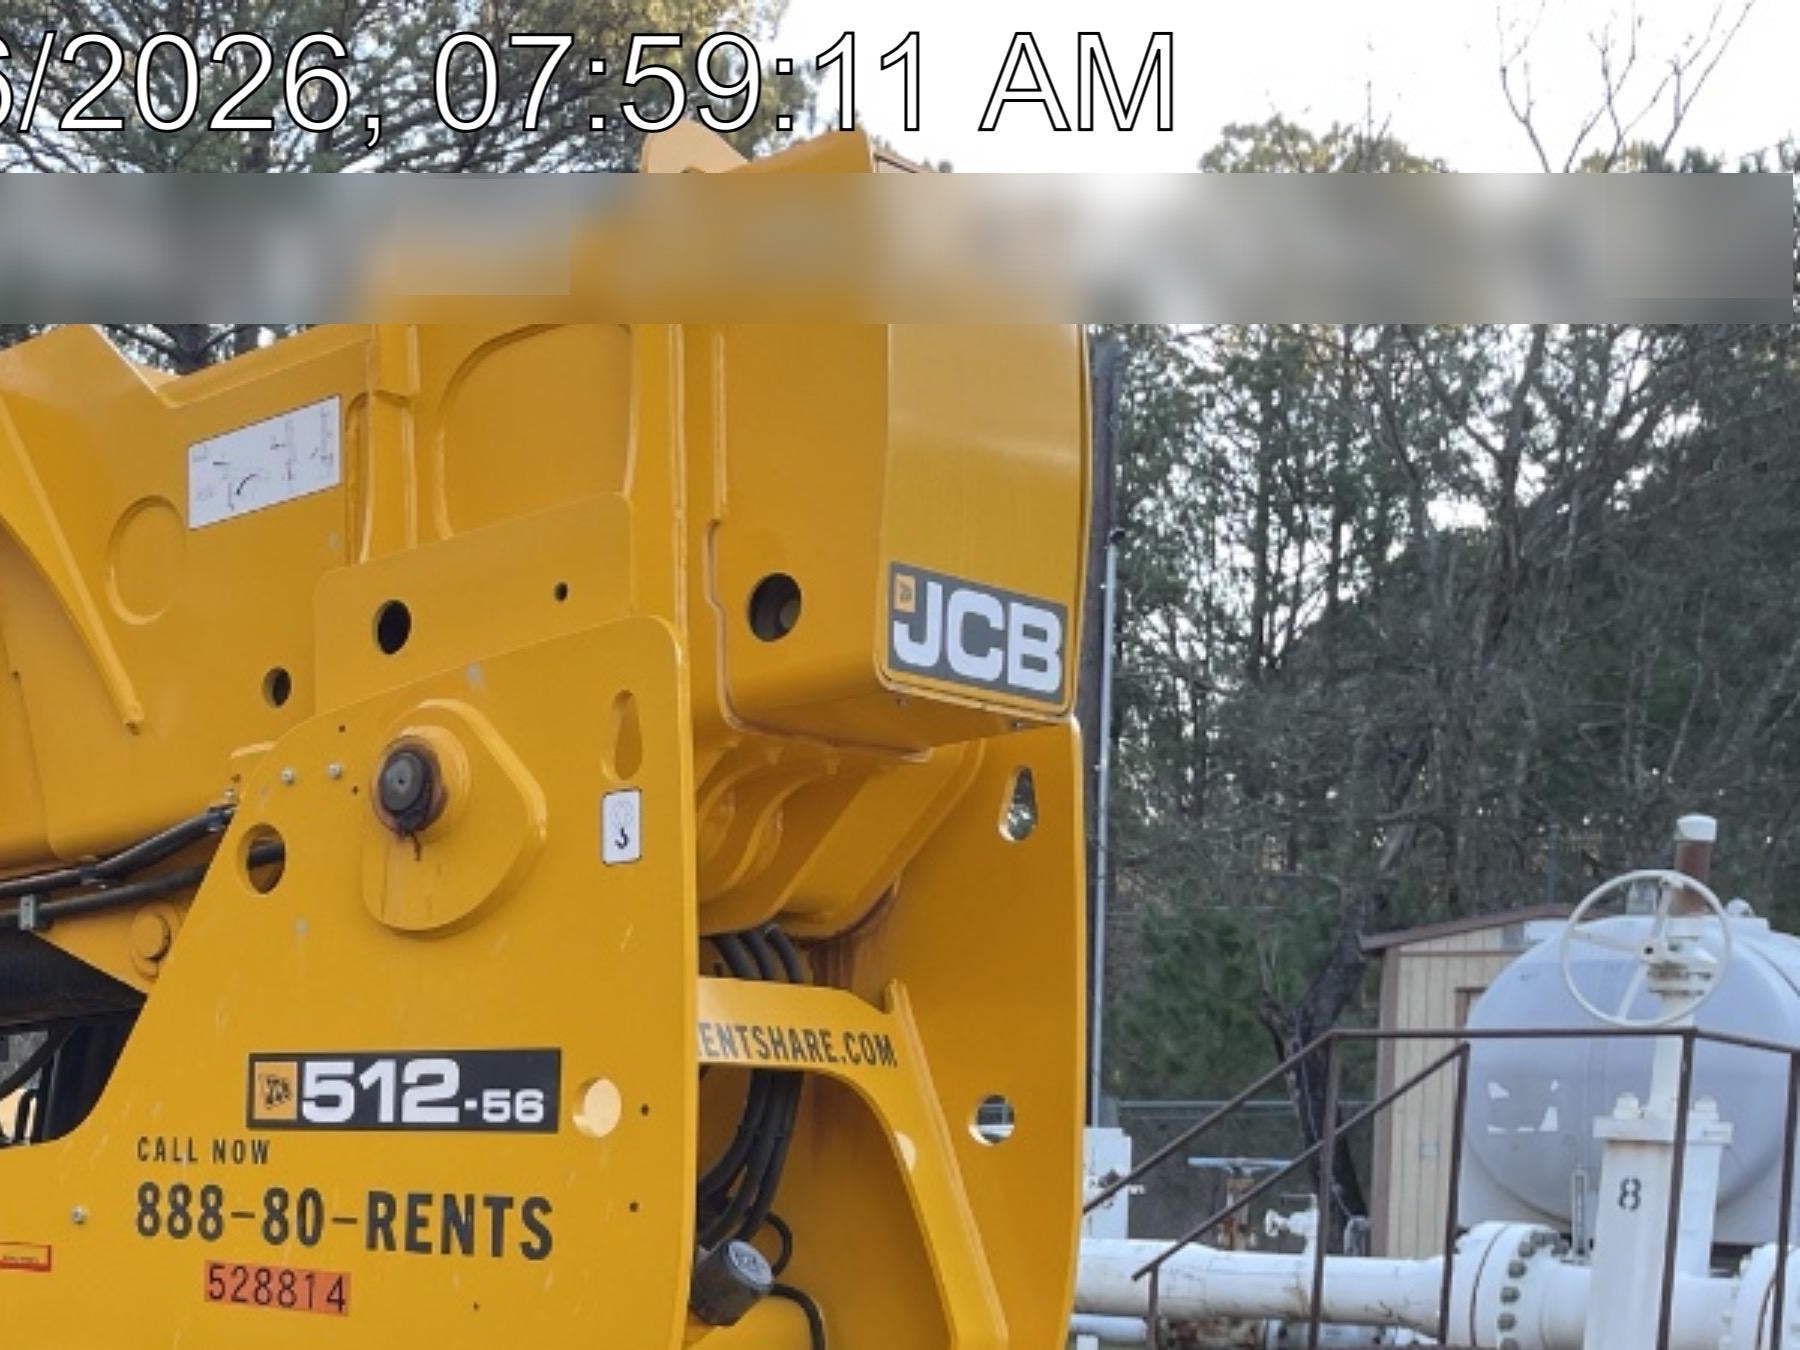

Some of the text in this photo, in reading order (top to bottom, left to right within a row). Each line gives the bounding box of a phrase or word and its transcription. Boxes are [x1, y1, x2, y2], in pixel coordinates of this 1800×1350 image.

[893, 580, 1063, 694] JCB
[697, 1021, 898, 1068] ENTSHARE.COM
[137, 1137, 270, 1165] CALL NOW
[1618, 1177, 1641, 1211] 8
[136, 1182, 553, 1260] 888-80-RENTS
[208, 1263, 346, 1312] 528814
